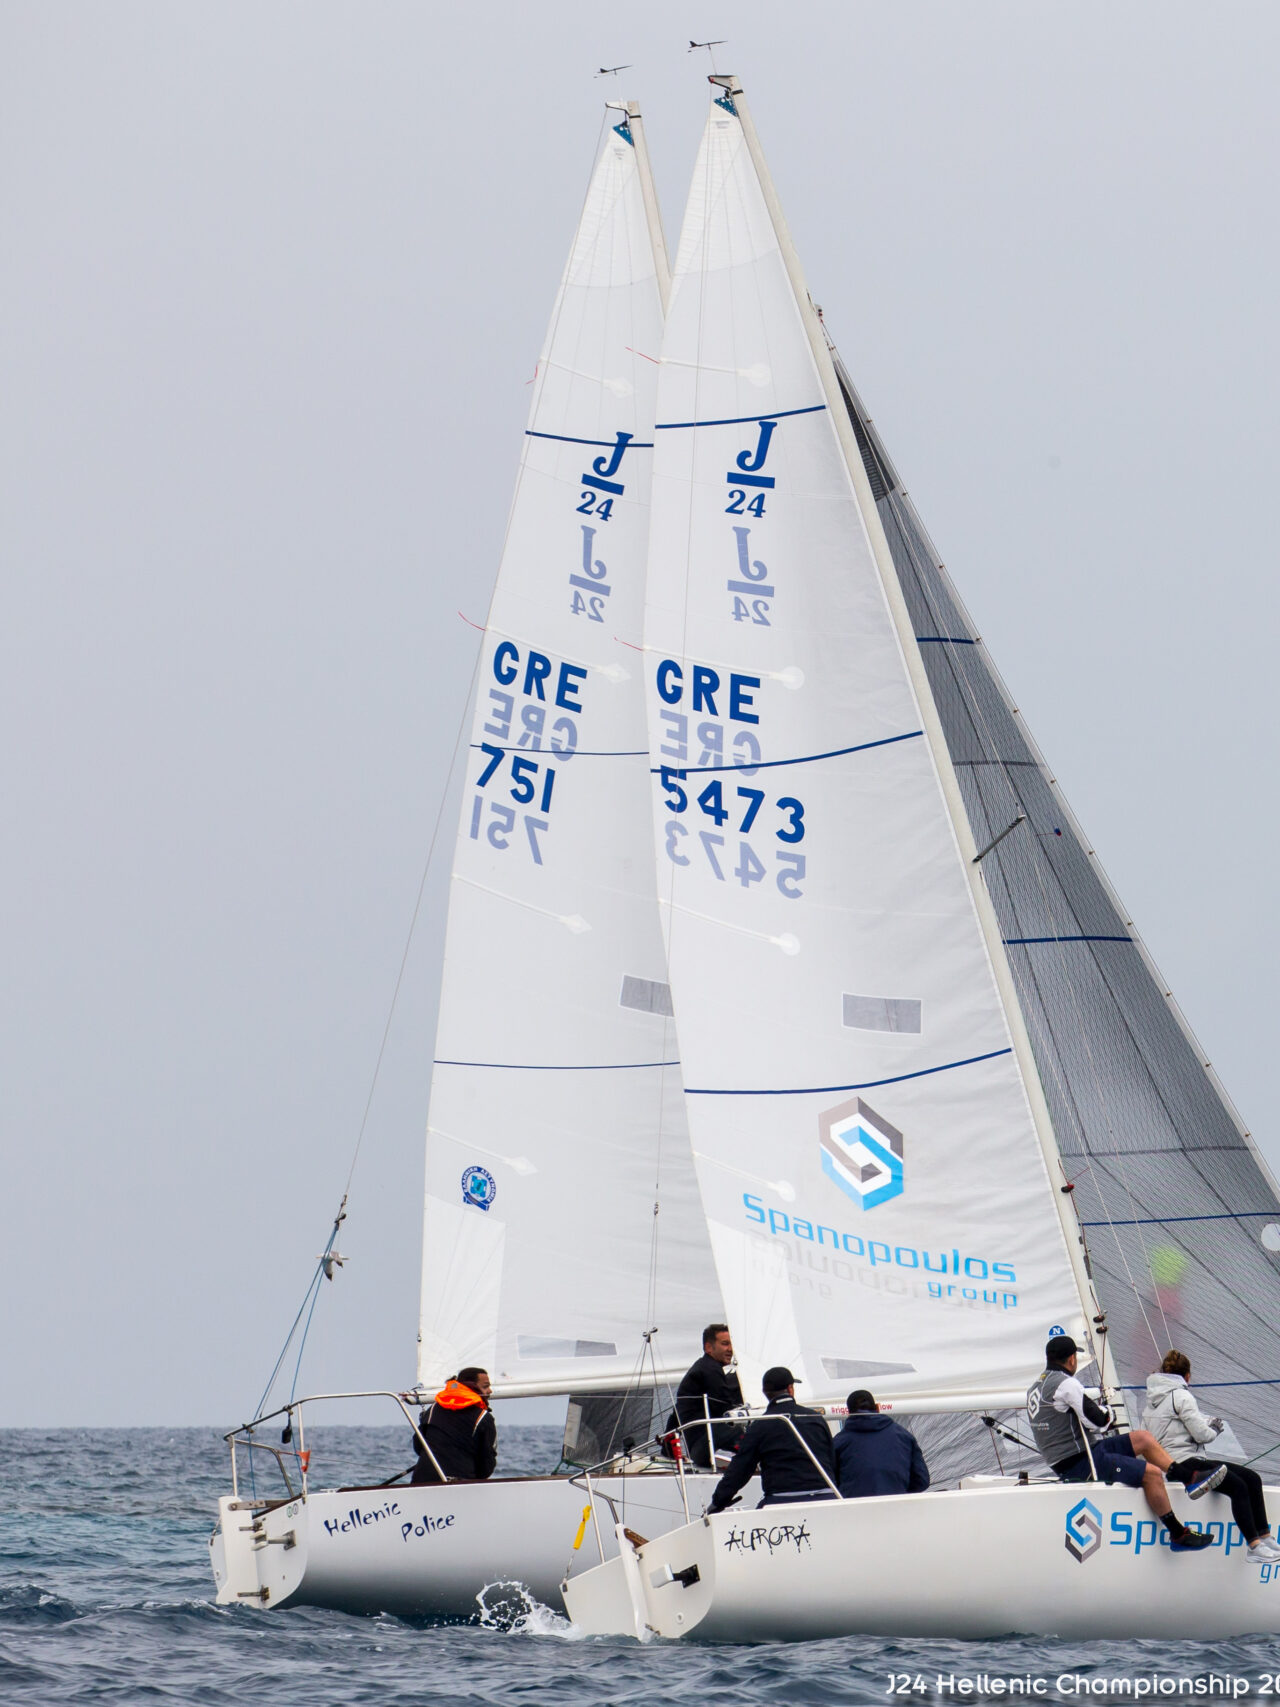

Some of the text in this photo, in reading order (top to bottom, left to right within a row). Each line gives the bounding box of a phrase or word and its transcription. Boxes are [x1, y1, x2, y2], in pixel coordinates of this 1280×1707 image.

[592, 431, 634, 478] J
[736, 420, 778, 472] J
[576, 491, 614, 521] 24
[725, 489, 767, 518] 24
[493, 641, 588, 713] GRE
[656, 659, 761, 725] GRE
[476, 742, 556, 814] 751
[659, 765, 806, 844] 5473
[743, 1193, 1018, 1283] Spanopoulos
[927, 1281, 1018, 1309] group
[323, 1502, 401, 1537] Hellenic
[401, 1514, 455, 1543] Police
[724, 1519, 812, 1556] AURORA
